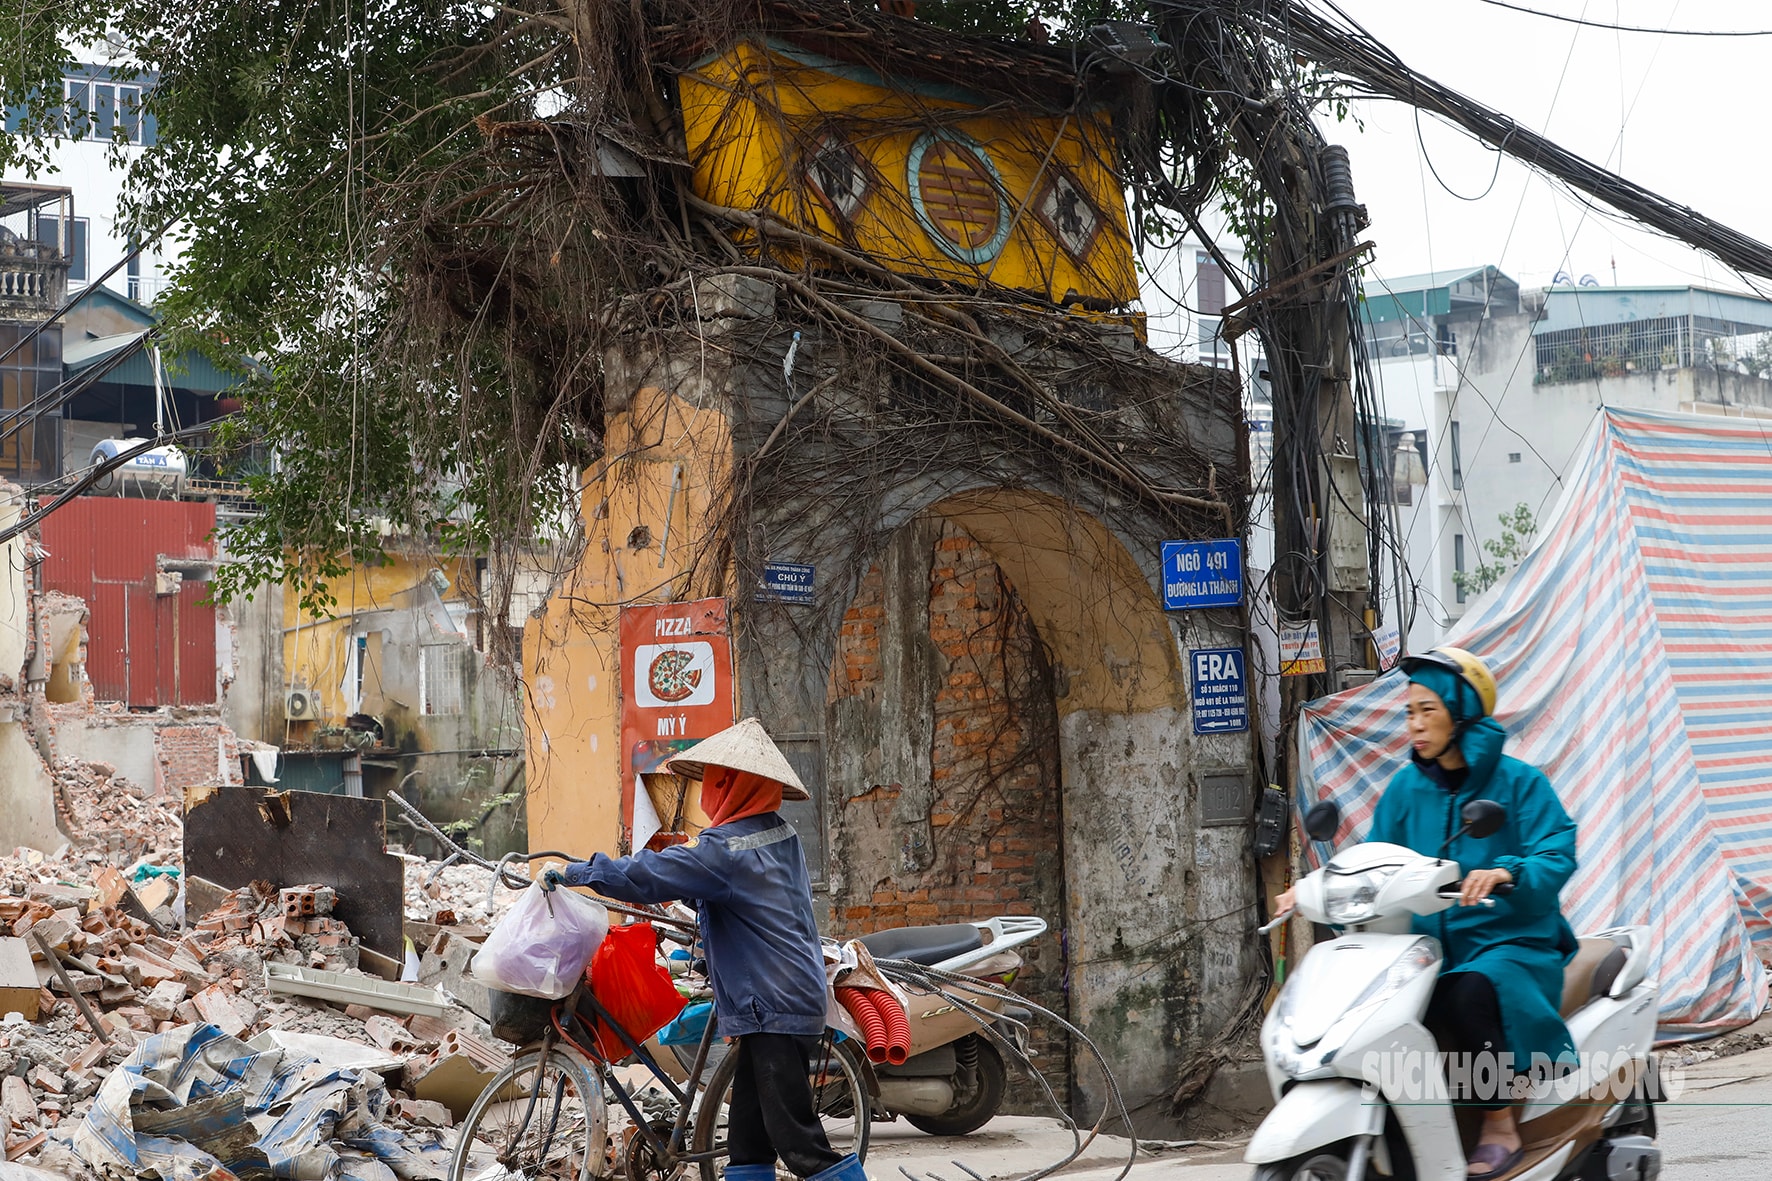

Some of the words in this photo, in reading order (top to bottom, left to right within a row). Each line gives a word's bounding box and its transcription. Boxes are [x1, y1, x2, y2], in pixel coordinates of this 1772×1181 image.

[1176, 549, 1200, 572] NGÕ
[1206, 552, 1227, 570] 491
[777, 572, 797, 582] CHÚ
[800, 573, 806, 583] Ý
[1168, 578, 1196, 598] ĐƯỜNG
[1197, 581, 1208, 595] LA
[1209, 576, 1238, 595] THÀNH
[655, 617, 692, 637] PIZZA
[1197, 653, 1240, 681] ERA
[657, 714, 676, 736] MỲ
[679, 713, 687, 736] Ý
